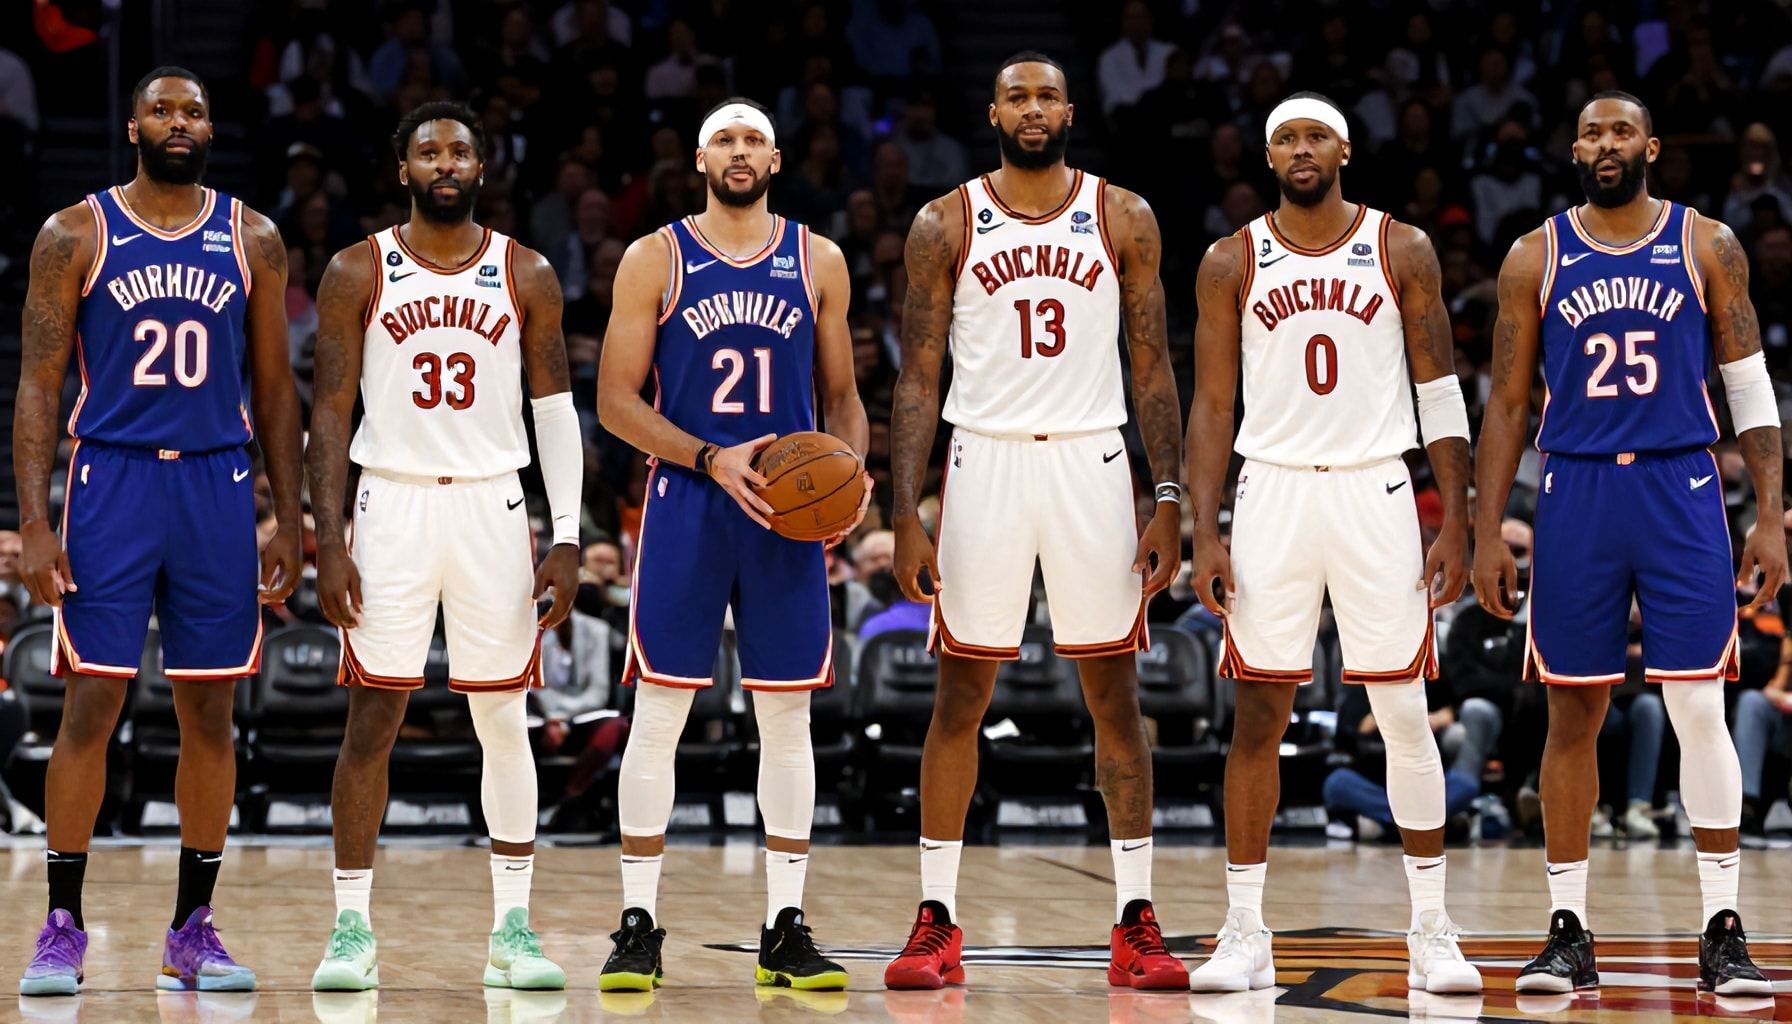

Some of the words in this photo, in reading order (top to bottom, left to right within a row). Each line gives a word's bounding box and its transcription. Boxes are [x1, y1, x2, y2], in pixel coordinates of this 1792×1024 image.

[133, 319, 208, 388] 20
[1014, 298, 1066, 359] 13
[412, 352, 476, 410] 33
[711, 348, 771, 413] 21
[1305, 334, 1338, 395] 0
[1584, 331, 1658, 397] 25
